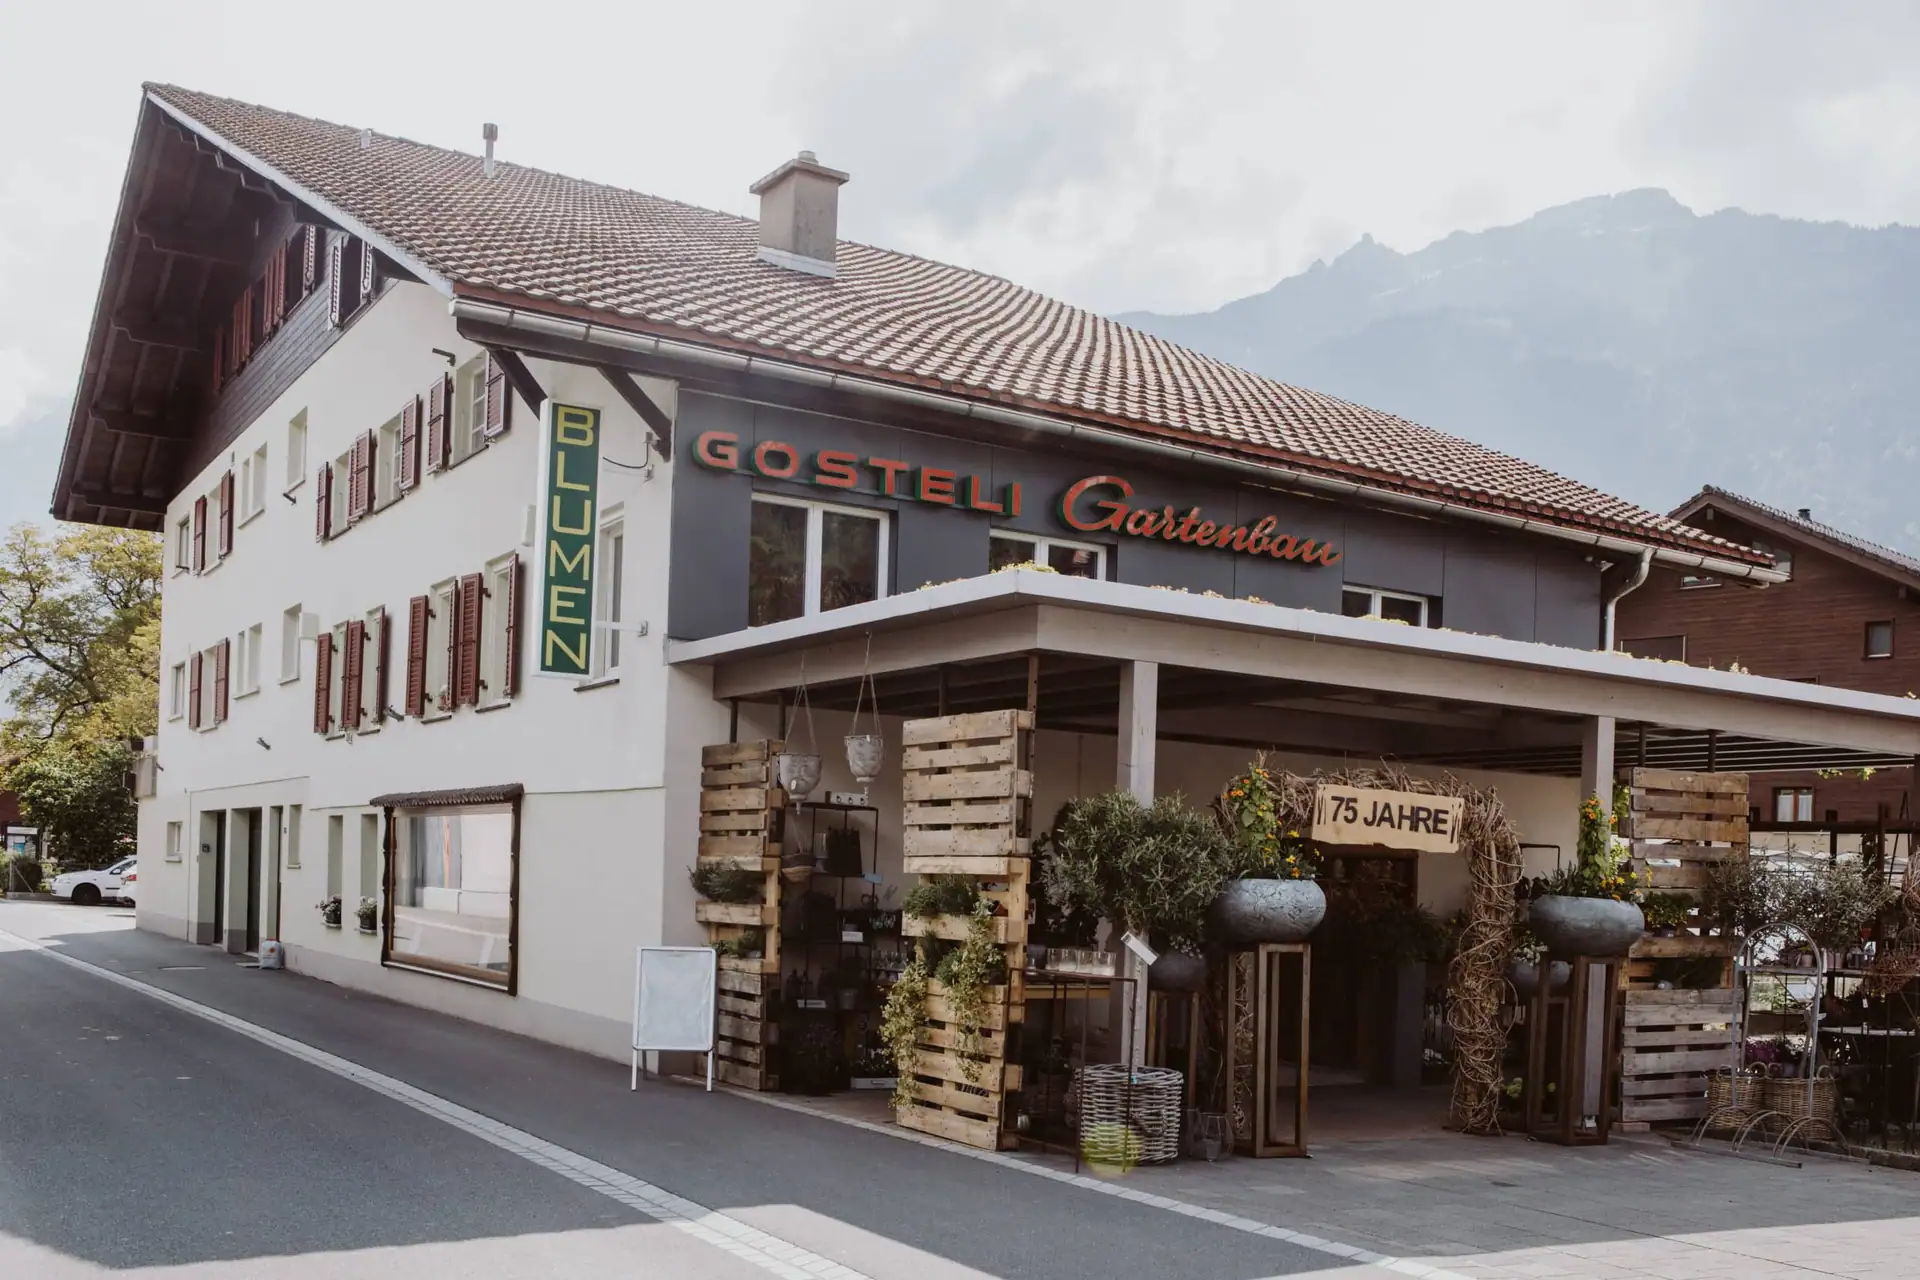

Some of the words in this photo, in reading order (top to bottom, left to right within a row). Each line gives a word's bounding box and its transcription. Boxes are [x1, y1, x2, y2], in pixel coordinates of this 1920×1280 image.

[545, 405, 595, 670] BLUMEN
[694, 430, 1022, 517] GOSTELI
[1060, 475, 1343, 567] Gartenbau
[1331, 795, 1358, 824] 75
[1363, 800, 1450, 835] JAHRE
